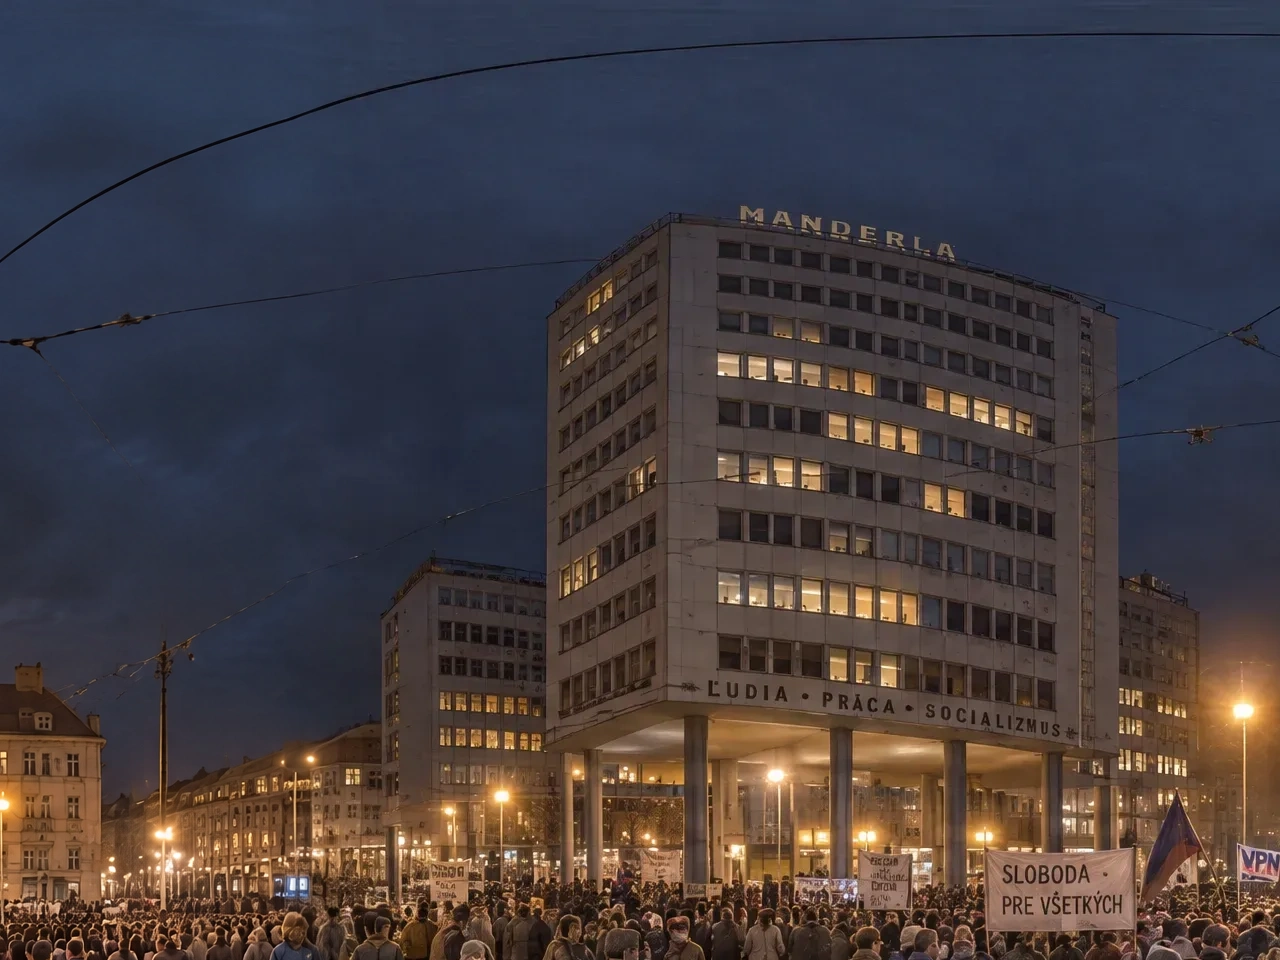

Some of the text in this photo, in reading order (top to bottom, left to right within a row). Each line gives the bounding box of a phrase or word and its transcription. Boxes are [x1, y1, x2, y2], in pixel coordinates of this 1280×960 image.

[740, 205, 956, 261] MANDERLA
[925, 703, 1061, 738] SOCIALIZMUS
[1002, 864, 1091, 884] SLOBODA
[1241, 848, 1280, 875] VPN
[1002, 890, 1123, 915] PRE VŠETKÝCH
